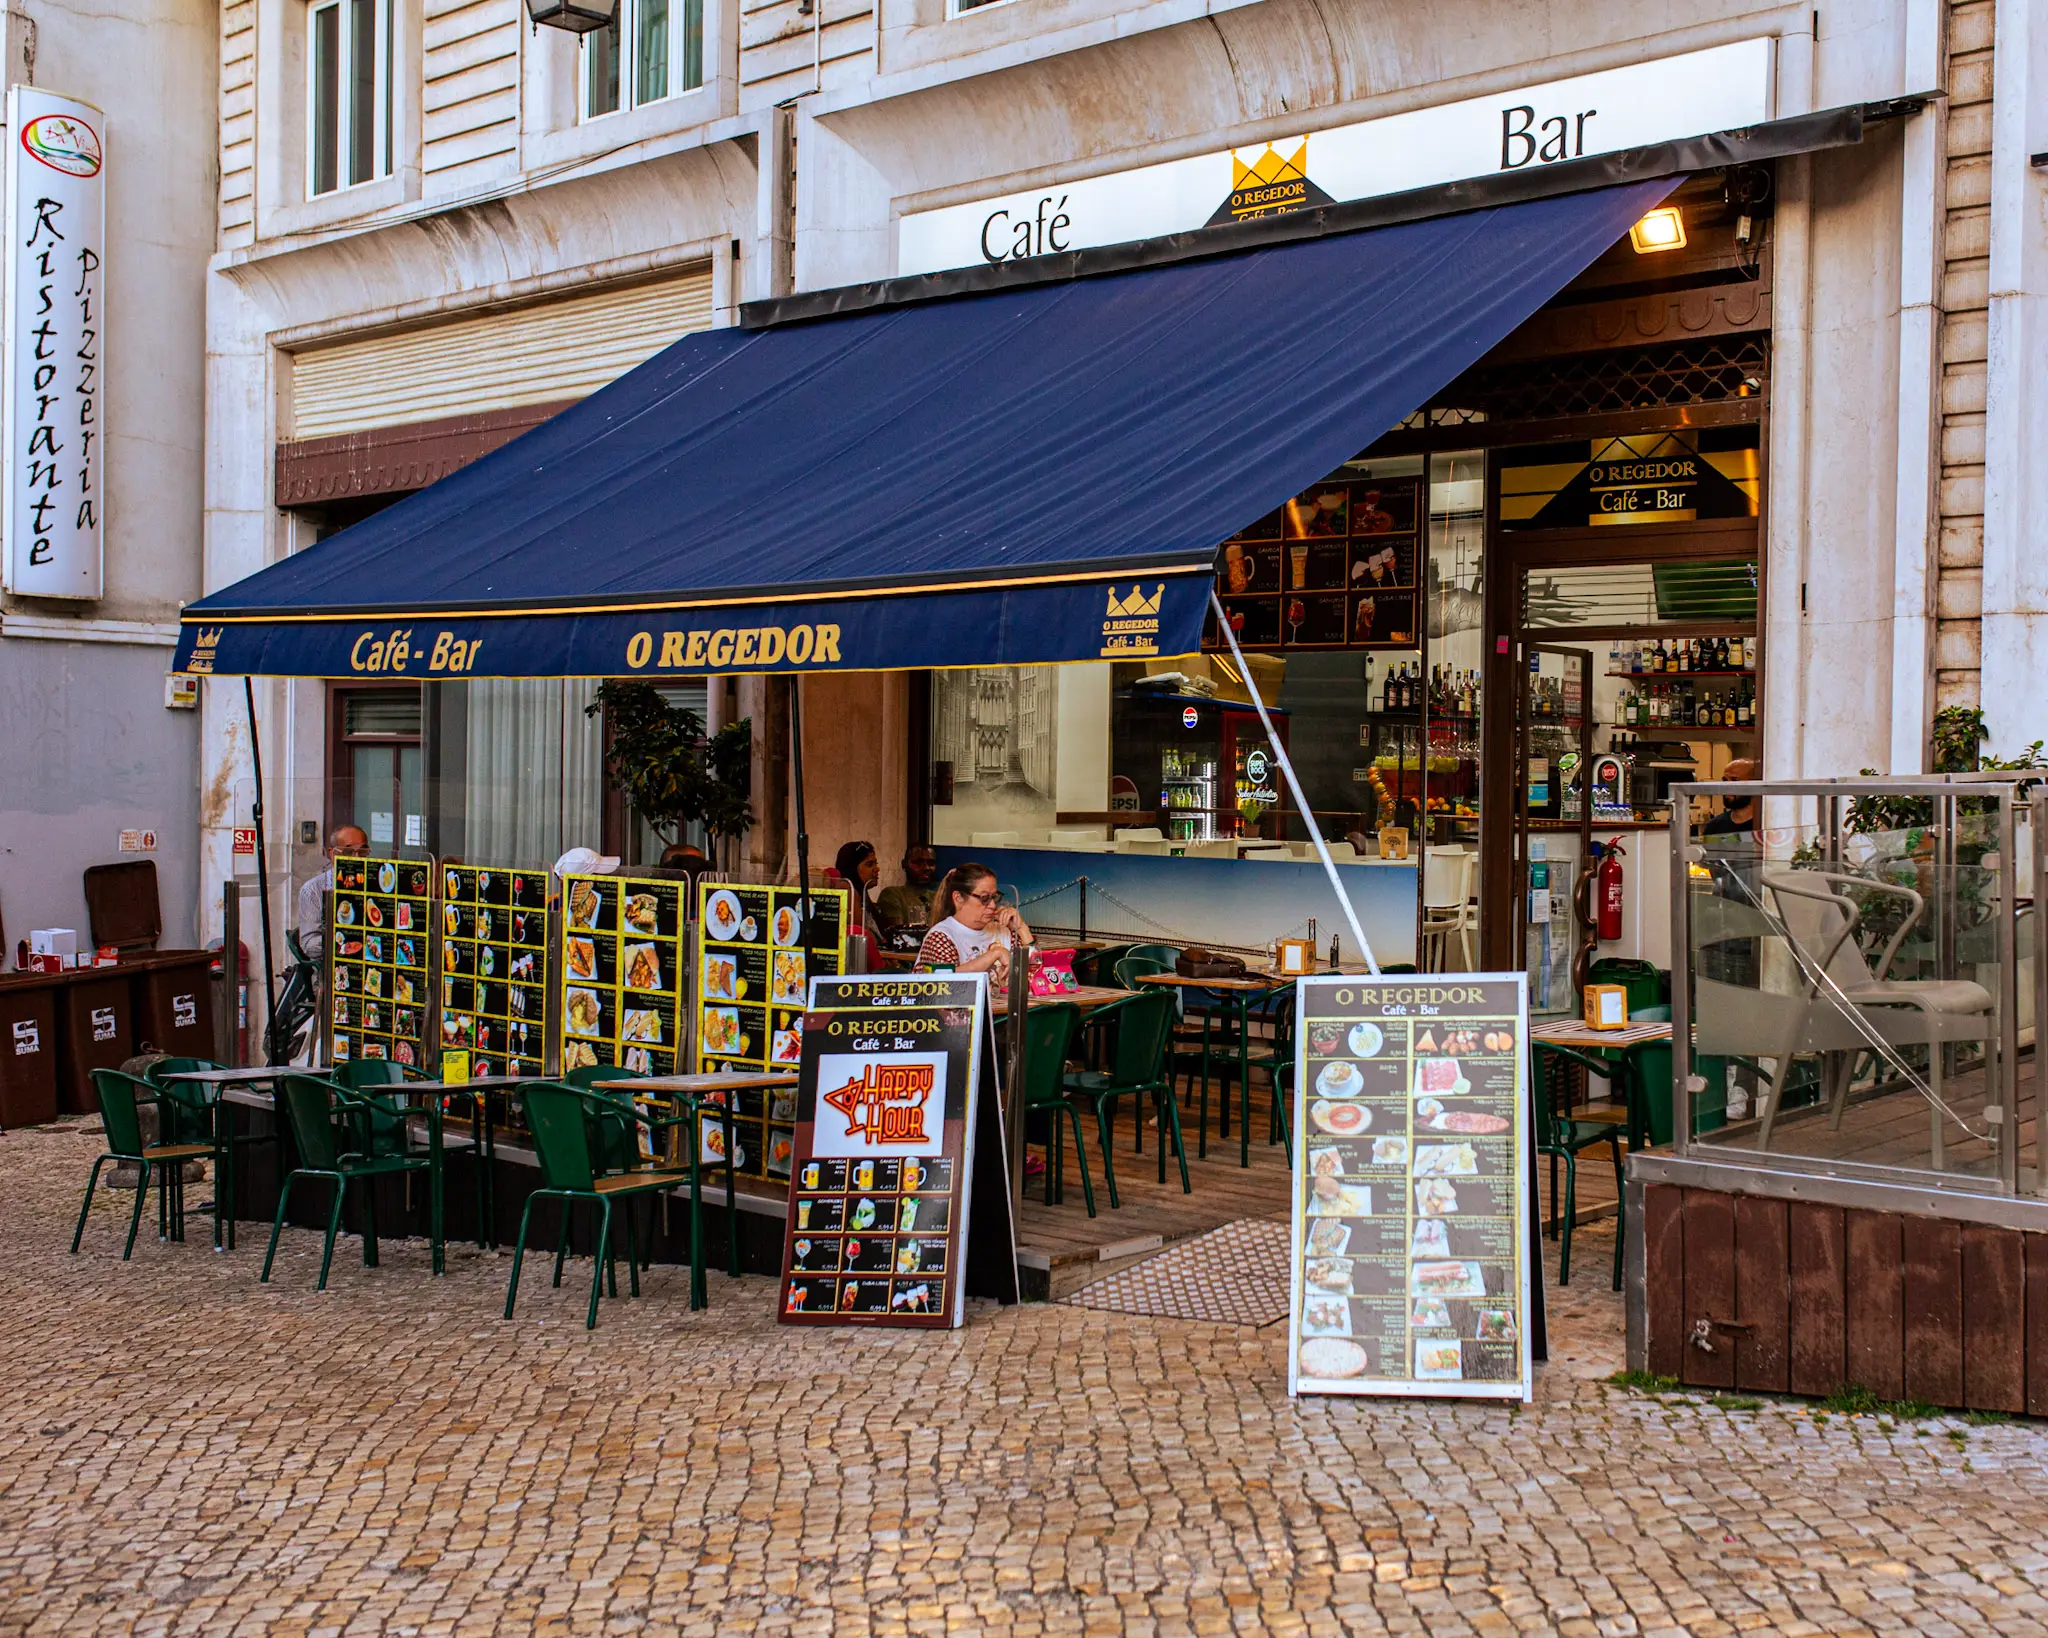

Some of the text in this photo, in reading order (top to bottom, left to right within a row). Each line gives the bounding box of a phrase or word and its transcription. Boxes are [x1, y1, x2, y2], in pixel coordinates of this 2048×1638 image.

[1500, 105, 1597, 170] Bar
[1231, 182, 1306, 206] O REGEDOR
[981, 195, 1070, 263] Café
[26, 197, 65, 567] Ristorante
[75, 247, 99, 530] Pizzeria
[1590, 460, 1698, 482] O REGEDOR
[1600, 490, 1638, 512] Café
[1656, 489, 1686, 509] Bar
[1102, 619, 1159, 630] O REGEDOR
[350, 629, 412, 672] Café
[428, 631, 483, 672] Bar
[626, 623, 841, 668] O REGEDOR
[1106, 636, 1128, 648] Café
[1135, 635, 1153, 646] Bar
[838, 981, 952, 998] O REGEDOR
[1335, 986, 1487, 1005] O REGEDOR
[872, 997, 891, 1005] Café
[901, 997, 916, 1005] Bar
[1381, 1004, 1407, 1015] Café
[1420, 1004, 1440, 1015] Bar
[174, 1017, 197, 1028] SUMA
[828, 1018, 942, 1036] O REGEDOR
[93, 1031, 116, 1042] SUMA
[853, 1038, 880, 1051] Café
[894, 1037, 916, 1050] Bar
[16, 1044, 40, 1055] SUMA
[863, 1064, 933, 1104] HAPPY
[865, 1102, 926, 1144] HOUR
